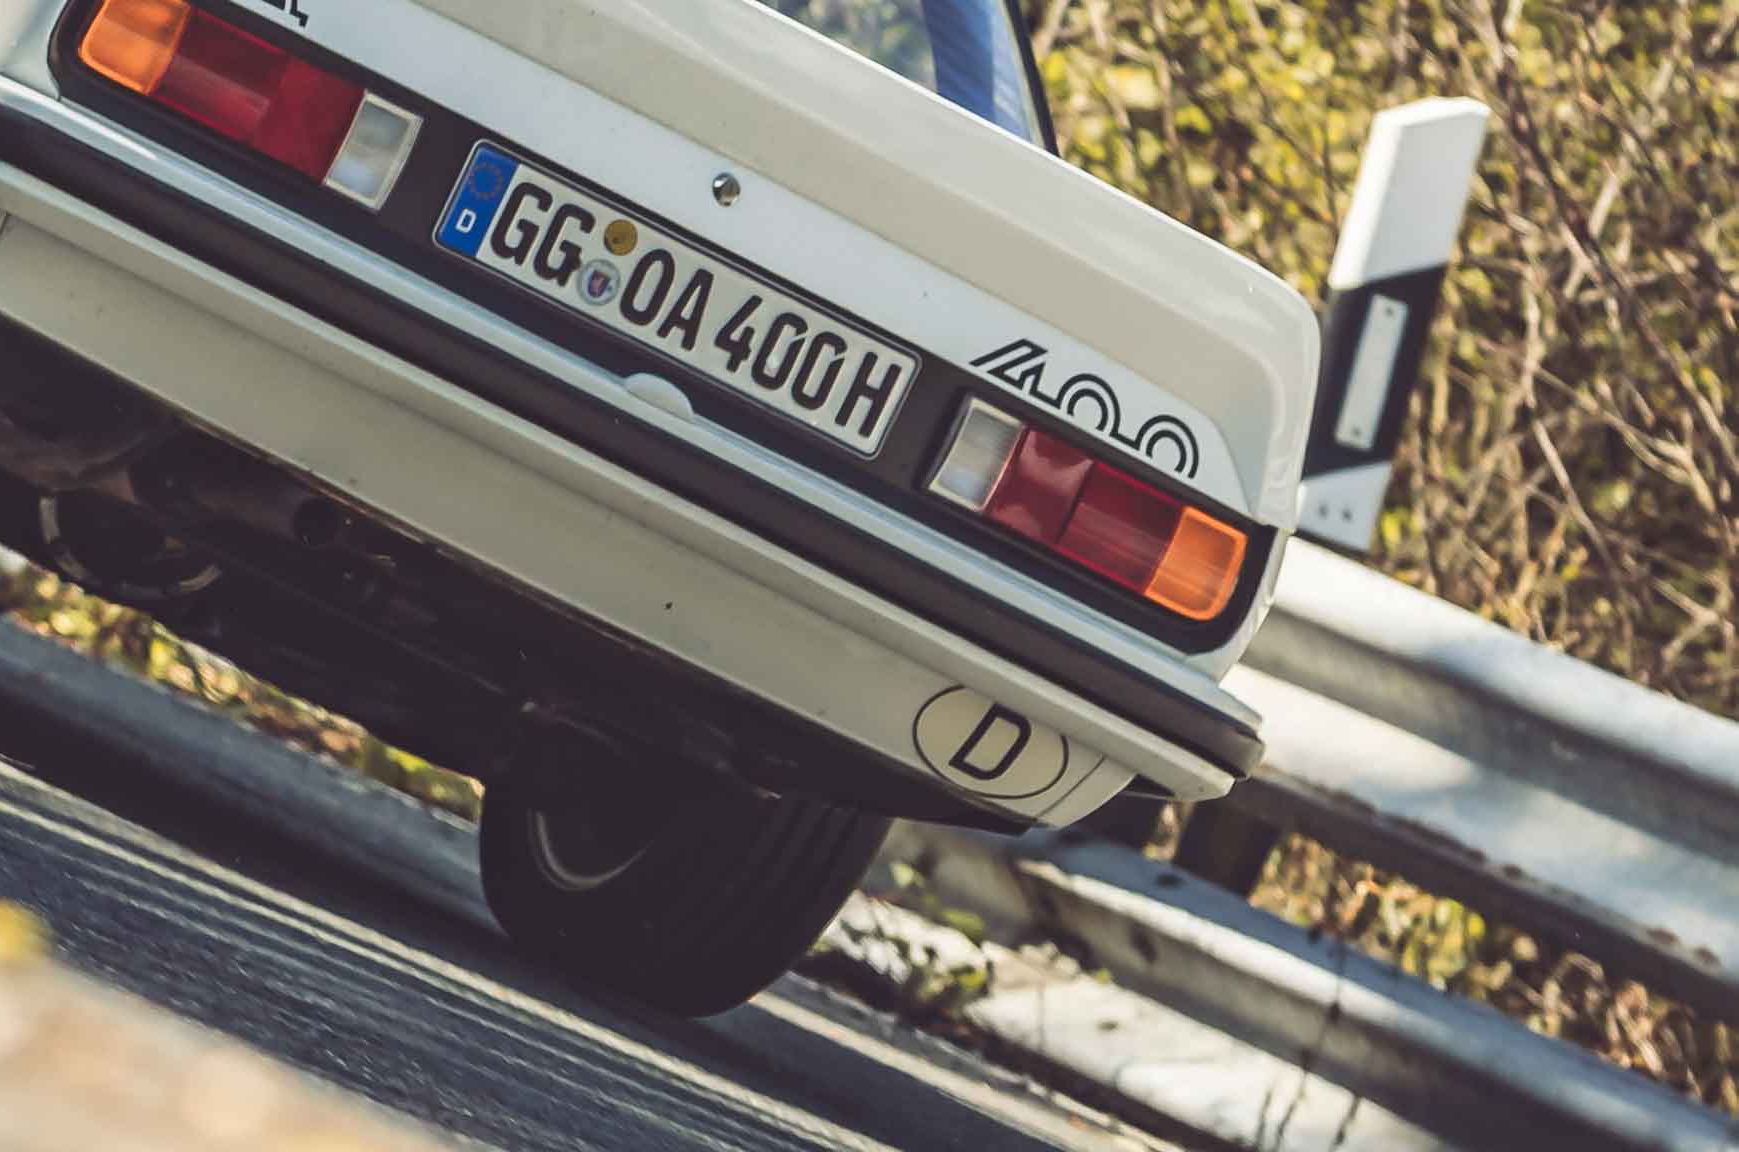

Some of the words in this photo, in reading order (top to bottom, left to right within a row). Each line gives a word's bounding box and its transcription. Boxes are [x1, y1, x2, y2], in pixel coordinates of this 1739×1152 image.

[455, 208, 477, 233] D
[490, 182, 596, 287] GG
[619, 248, 715, 352] OA
[948, 702, 1032, 781] D
